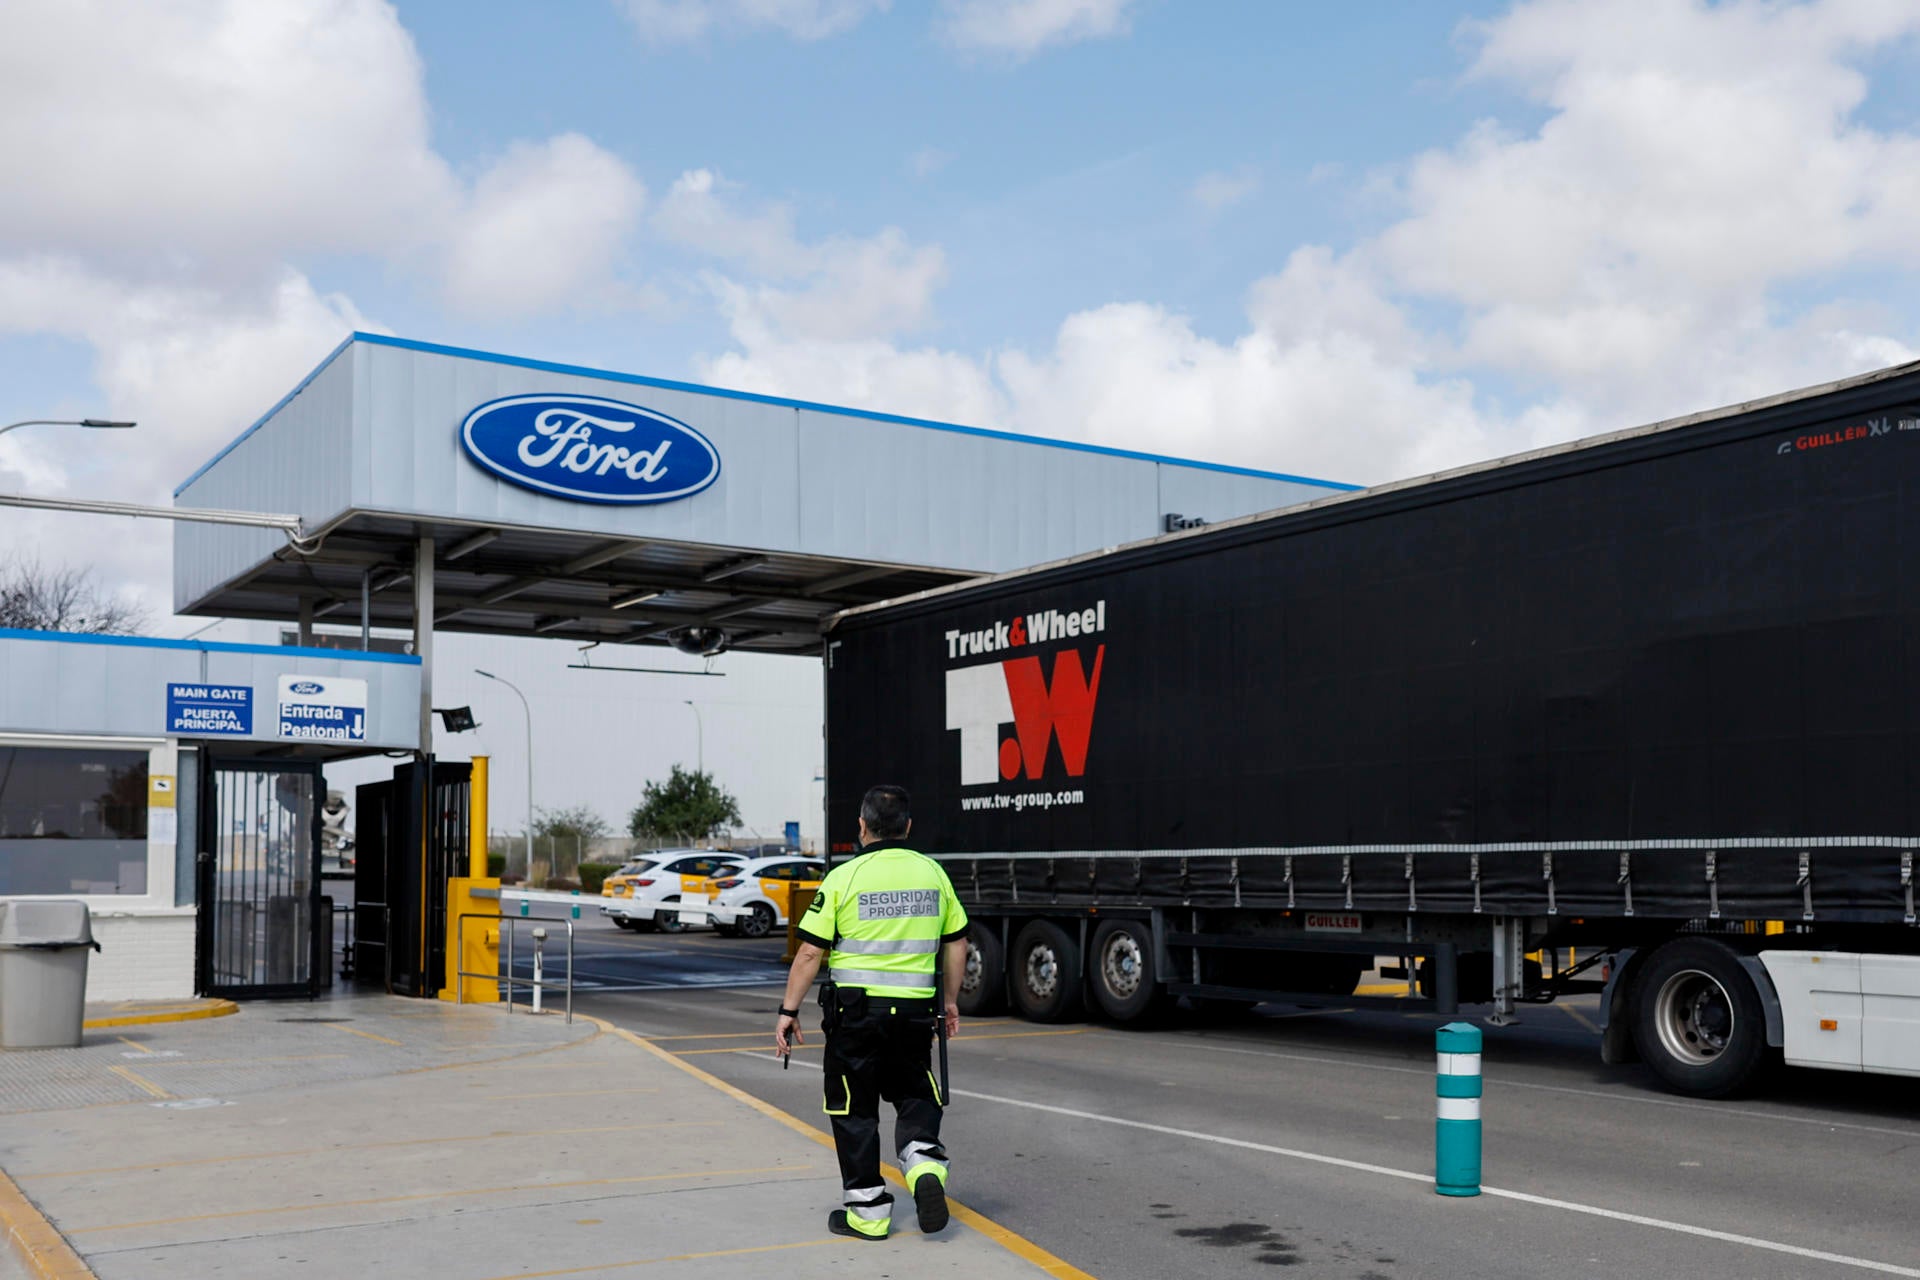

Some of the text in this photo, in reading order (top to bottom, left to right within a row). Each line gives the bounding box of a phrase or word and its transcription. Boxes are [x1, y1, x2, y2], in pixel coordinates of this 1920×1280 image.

[517, 408, 673, 483] Ford
[945, 600, 1106, 659] Truck&Wheel
[173, 687, 247, 701] MAIN GATE
[294, 682, 319, 693] Ford
[183, 708, 237, 720] PUERTA
[281, 704, 343, 721] Entrada
[174, 719, 245, 731] PRINCIPAL
[281, 722, 350, 740] Peatonal
[961, 790, 1084, 811] www.tw-group.com
[869, 904, 933, 917] PROSEGUR
